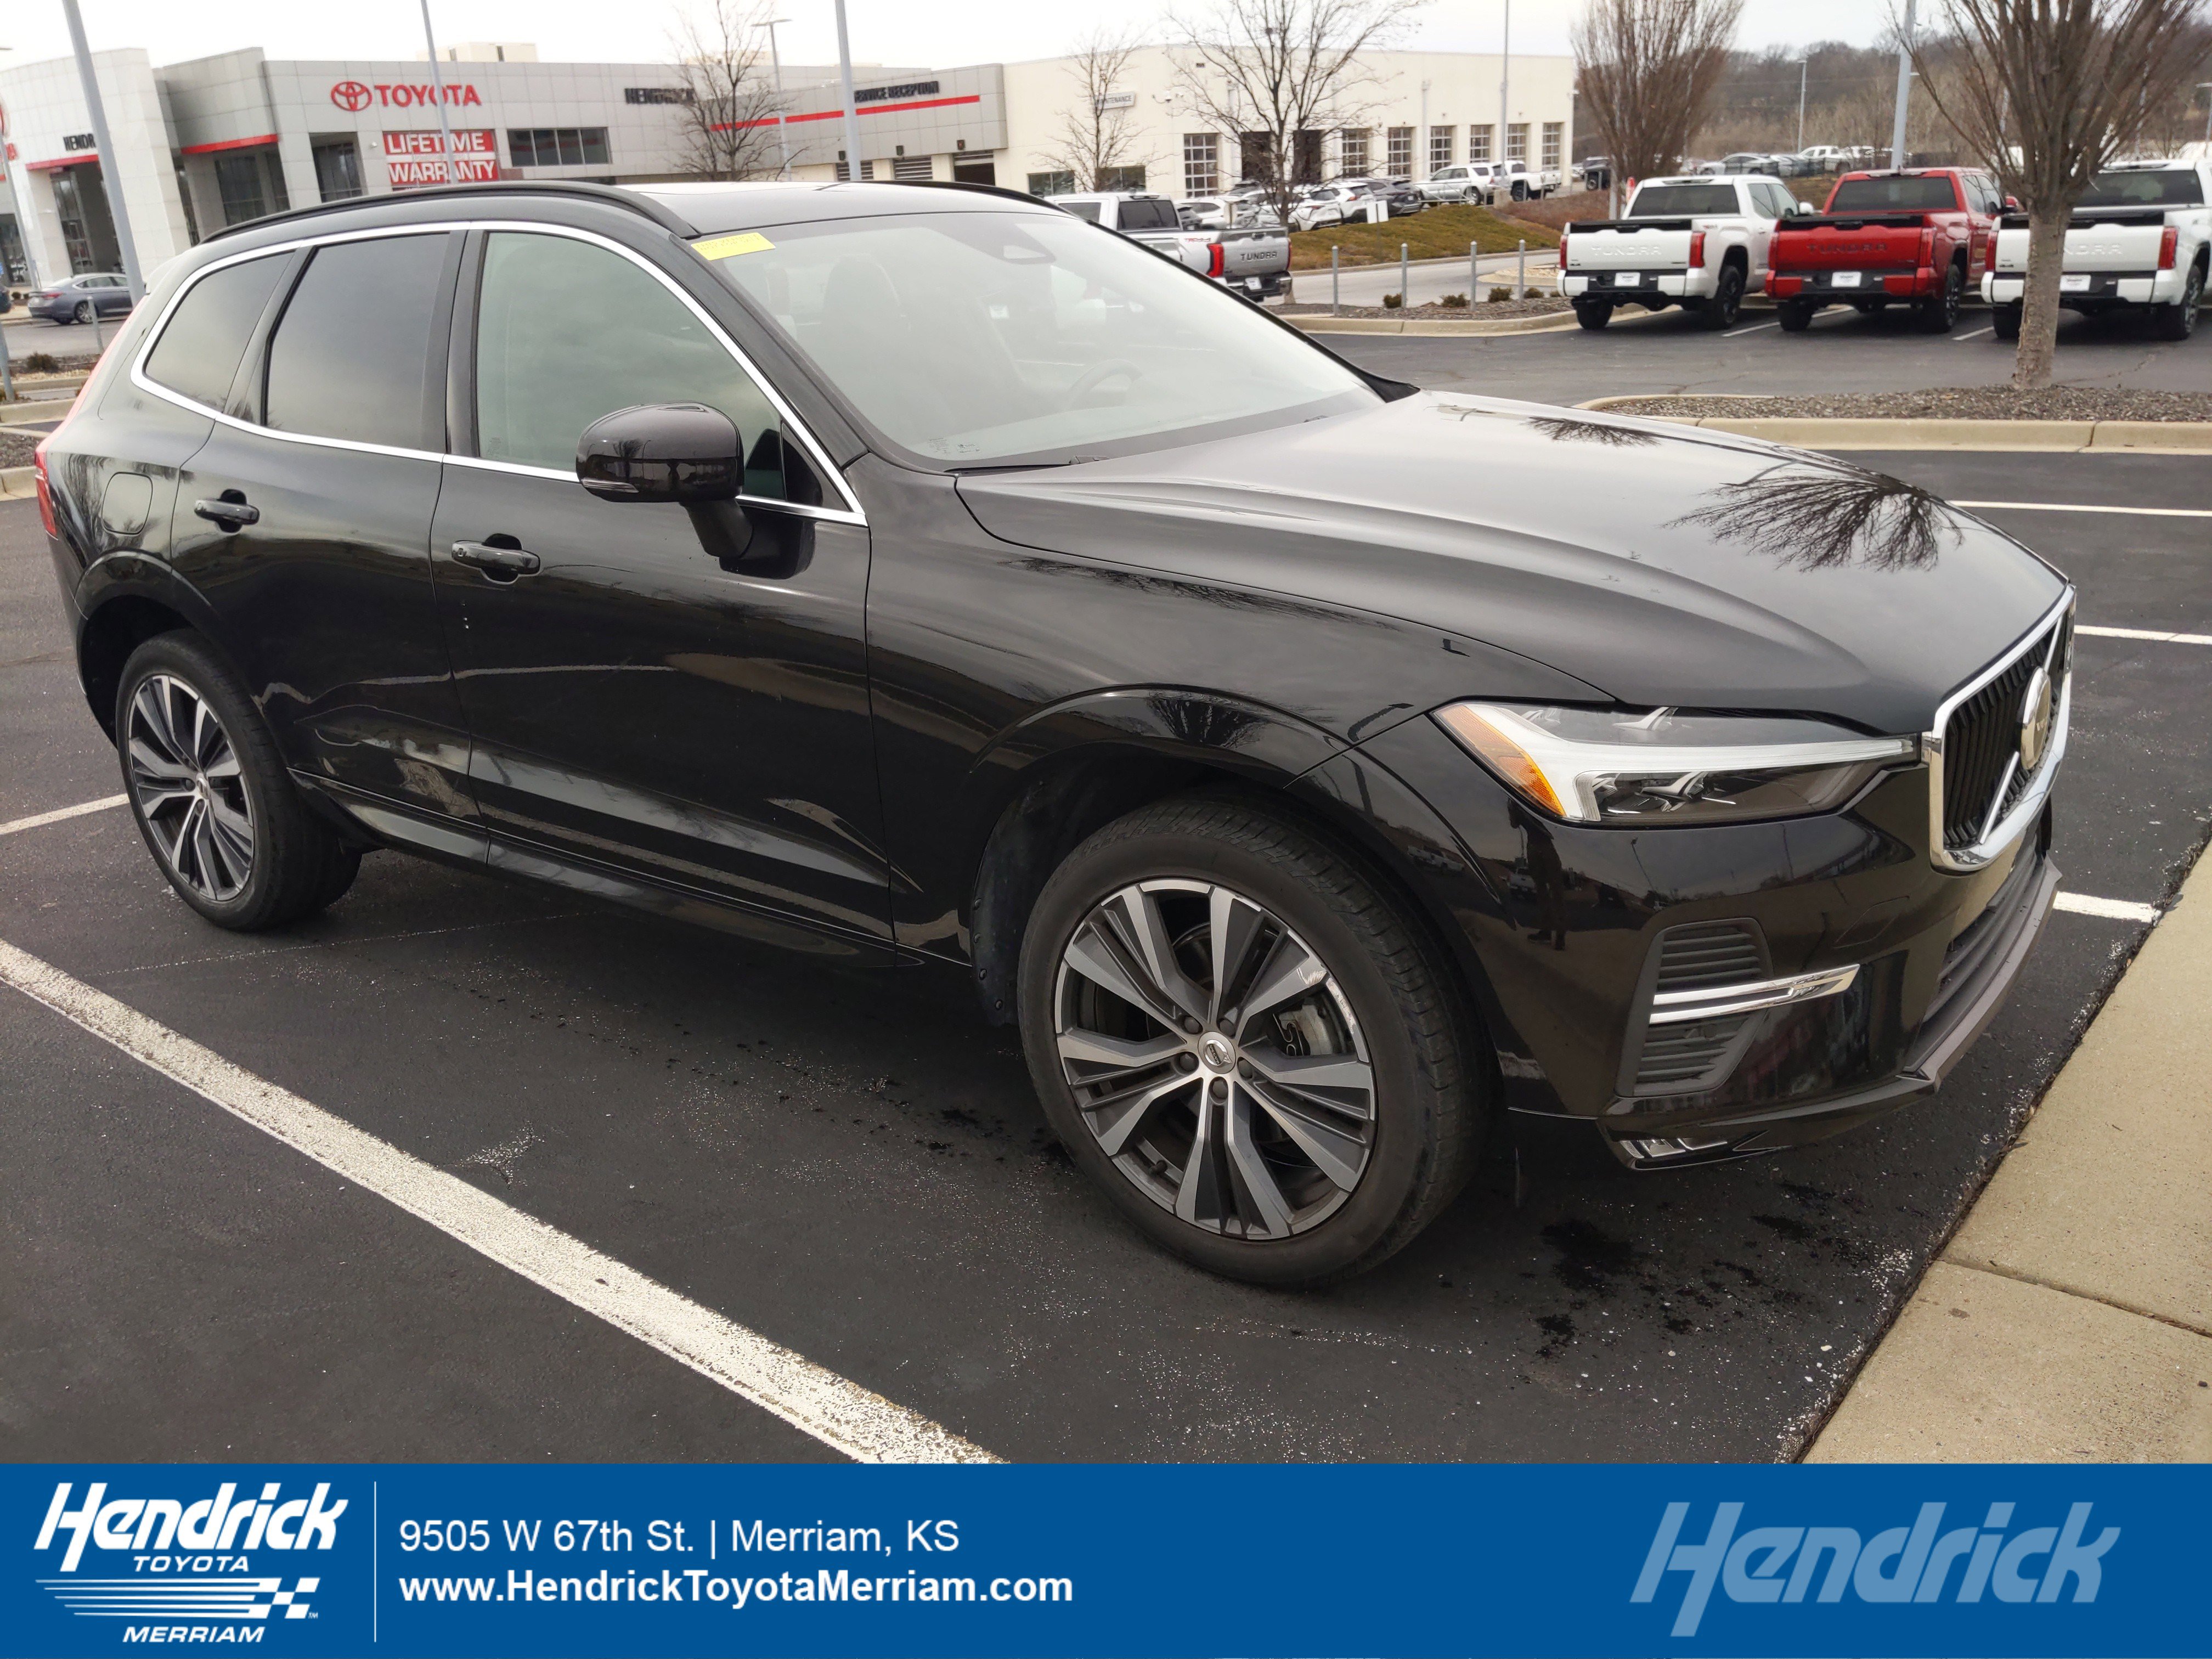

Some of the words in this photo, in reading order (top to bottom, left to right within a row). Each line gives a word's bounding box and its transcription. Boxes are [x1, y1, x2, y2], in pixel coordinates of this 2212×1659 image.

[374, 84, 482, 108] TOYOTA
[63, 133, 96, 151] HENDR
[387, 132, 485, 153] LIFETME
[1240, 251, 1278, 262] TUNDRA
[1208, 1044, 1221, 1065] VOLVO
